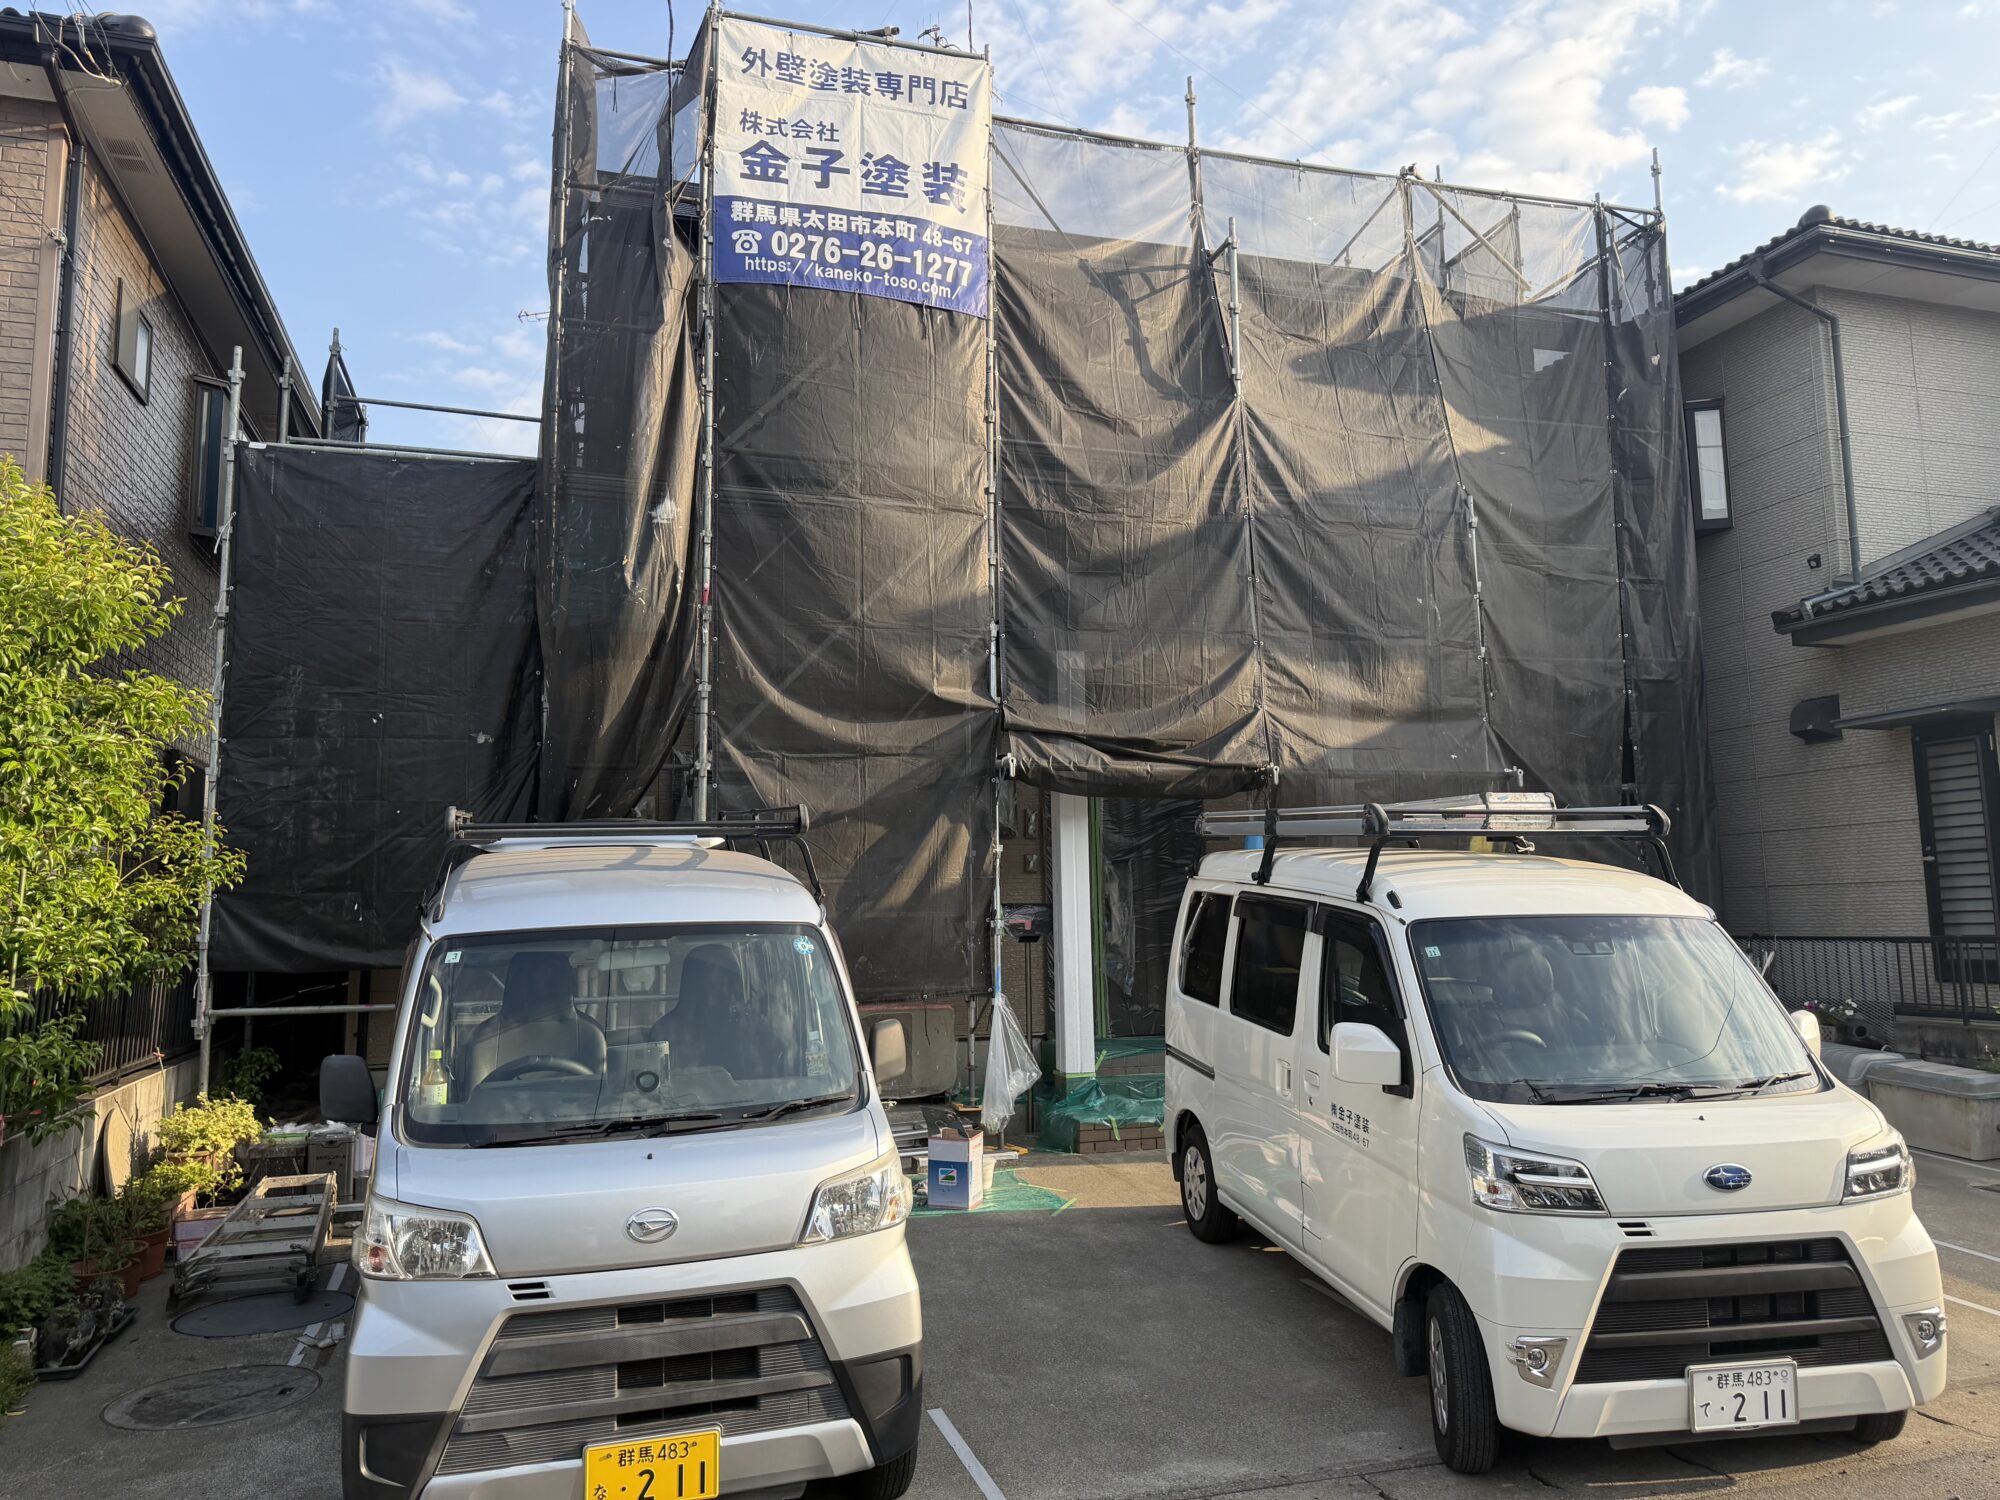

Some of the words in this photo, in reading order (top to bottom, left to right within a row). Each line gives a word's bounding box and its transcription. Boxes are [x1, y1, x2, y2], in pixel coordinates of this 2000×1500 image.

[741, 46, 968, 110] 外壁塗装専門店
[739, 107, 840, 143] 株式会社
[739, 140, 968, 214] 金子塗装
[731, 201, 917, 242] 群馬県太田市本町
[922, 226, 973, 255] 48-67
[744, 256, 962, 300] https://kaneko-toso.com/
[771, 230, 974, 287] 0276-26-1277
[1716, 1370, 1772, 1389] 群馬483
[1699, 1402, 1710, 1417] て
[618, 1441, 689, 1467] 群馬483
